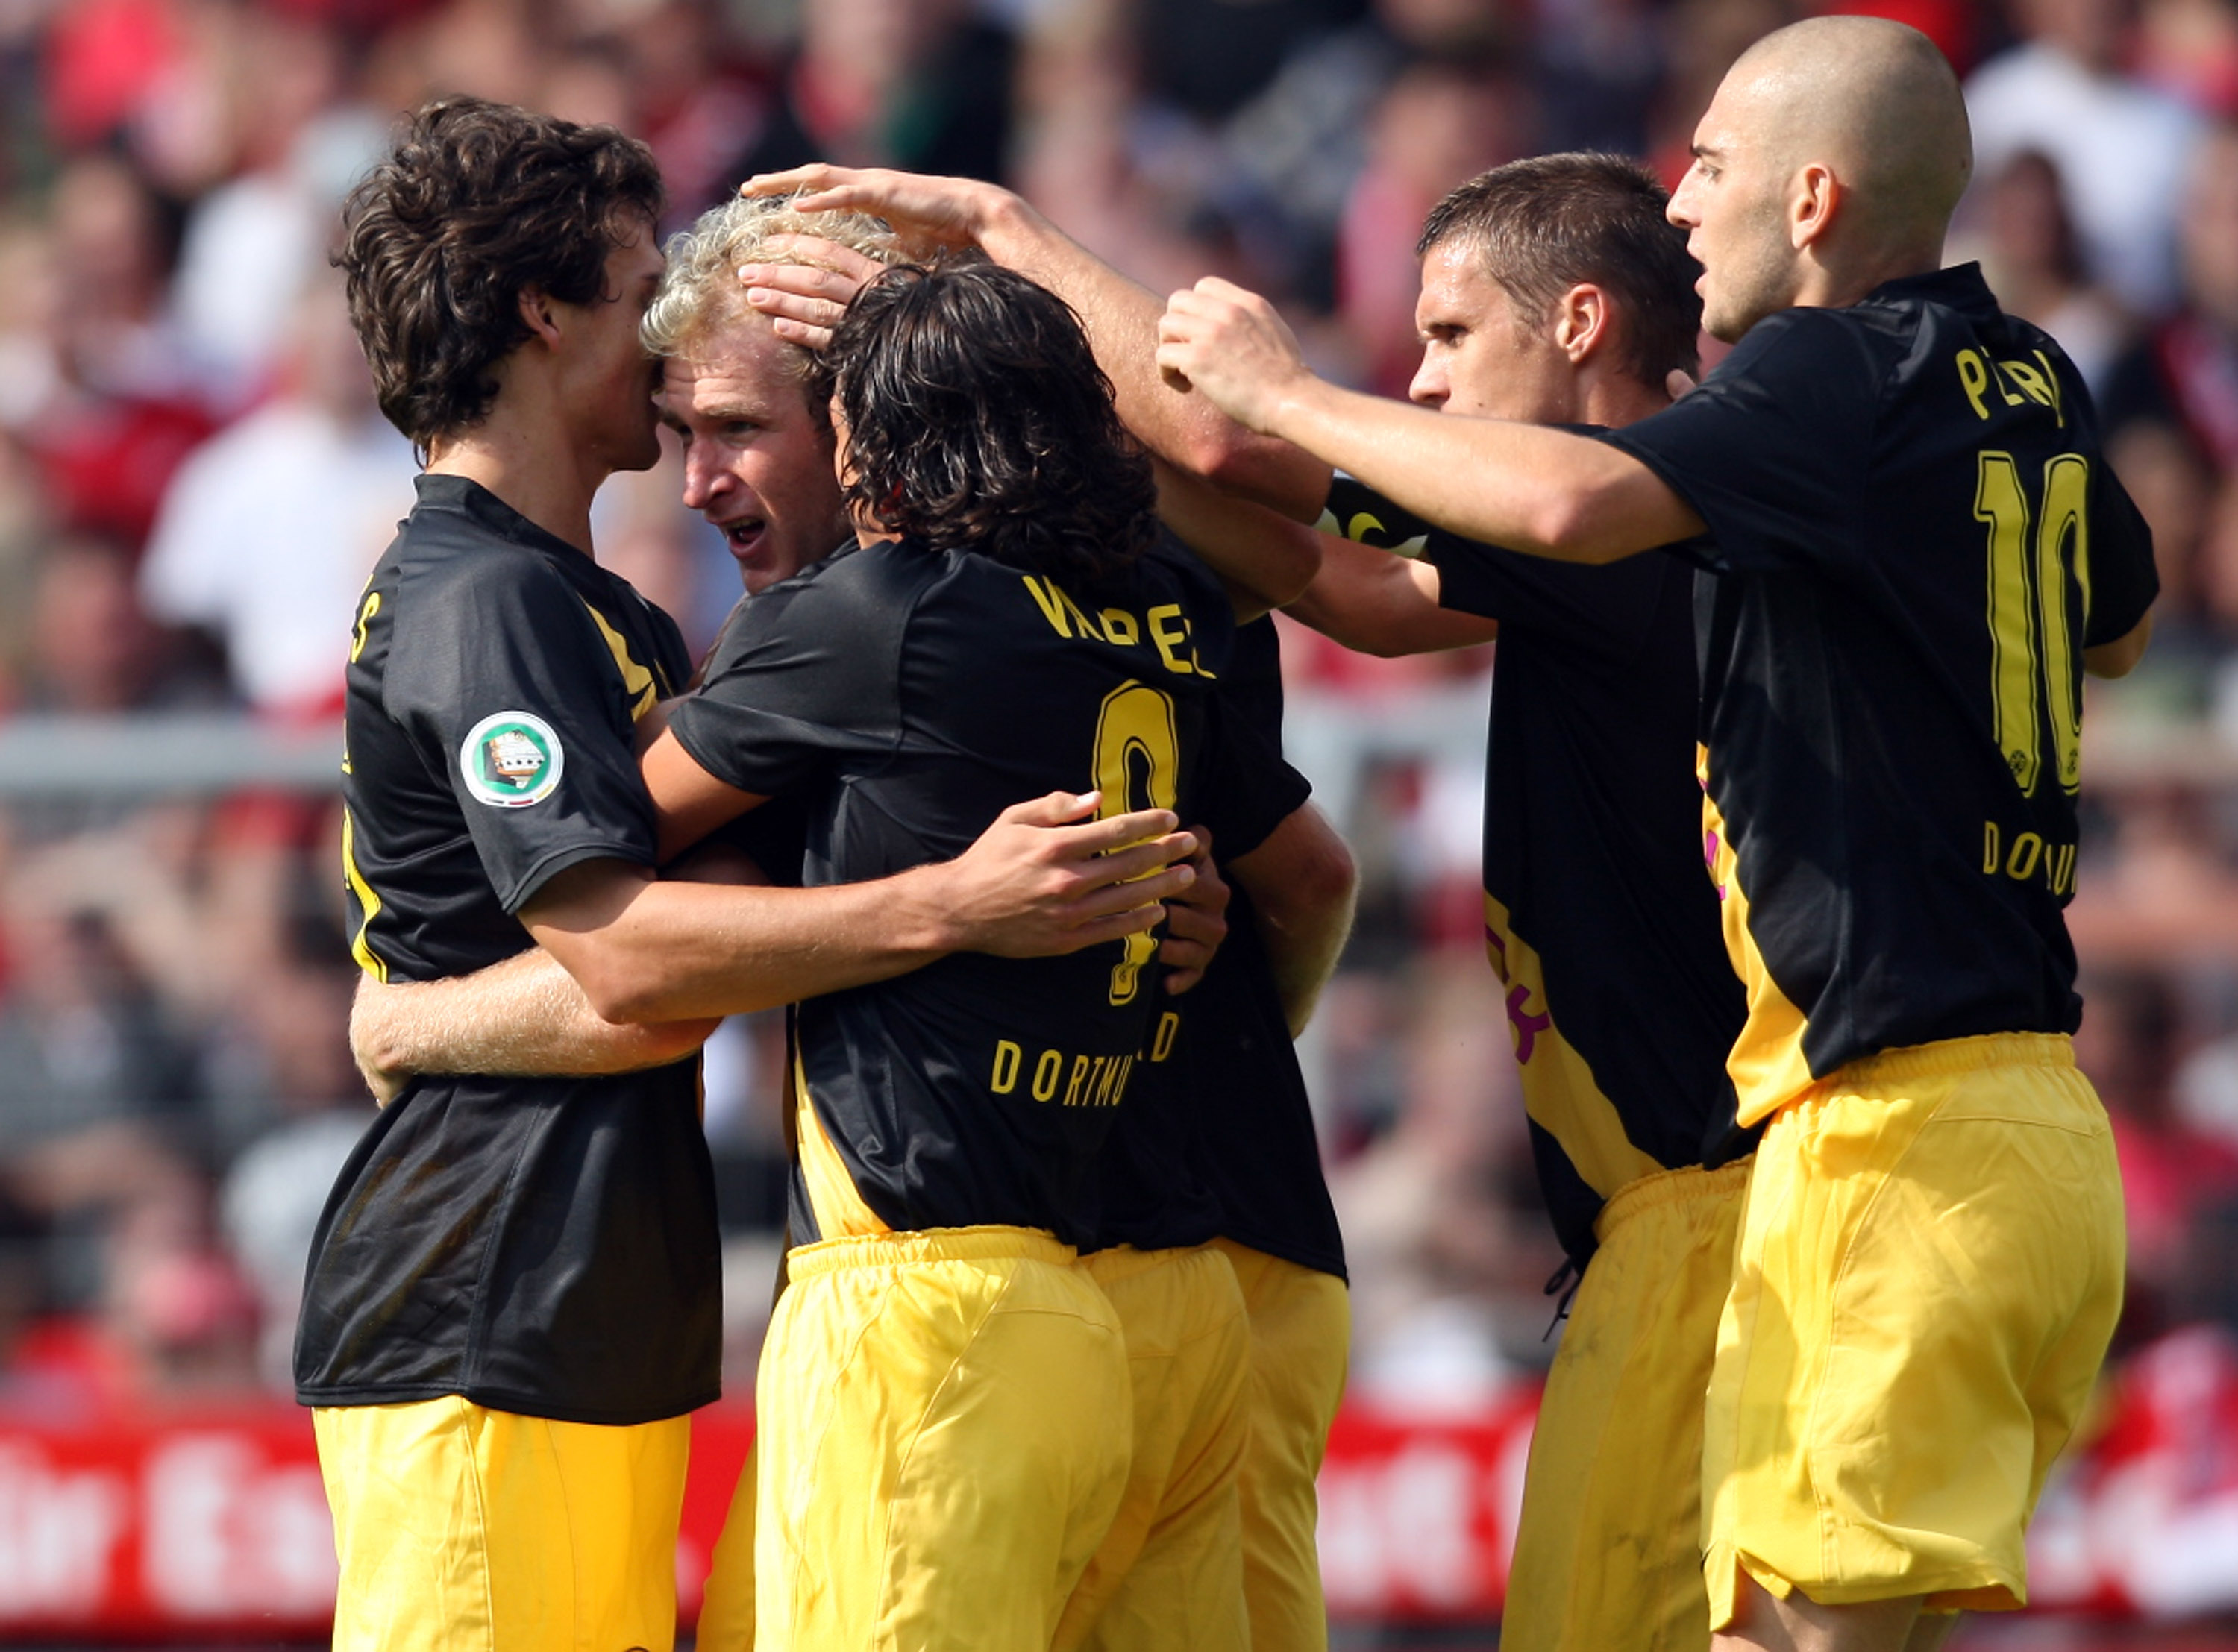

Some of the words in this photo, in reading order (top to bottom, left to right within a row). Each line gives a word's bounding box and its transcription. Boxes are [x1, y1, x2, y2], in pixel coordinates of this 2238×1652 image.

[1974, 450, 2090, 799] 10
[1091, 678, 1179, 1006] 9
[991, 1011, 1179, 1107] DORTMUD
